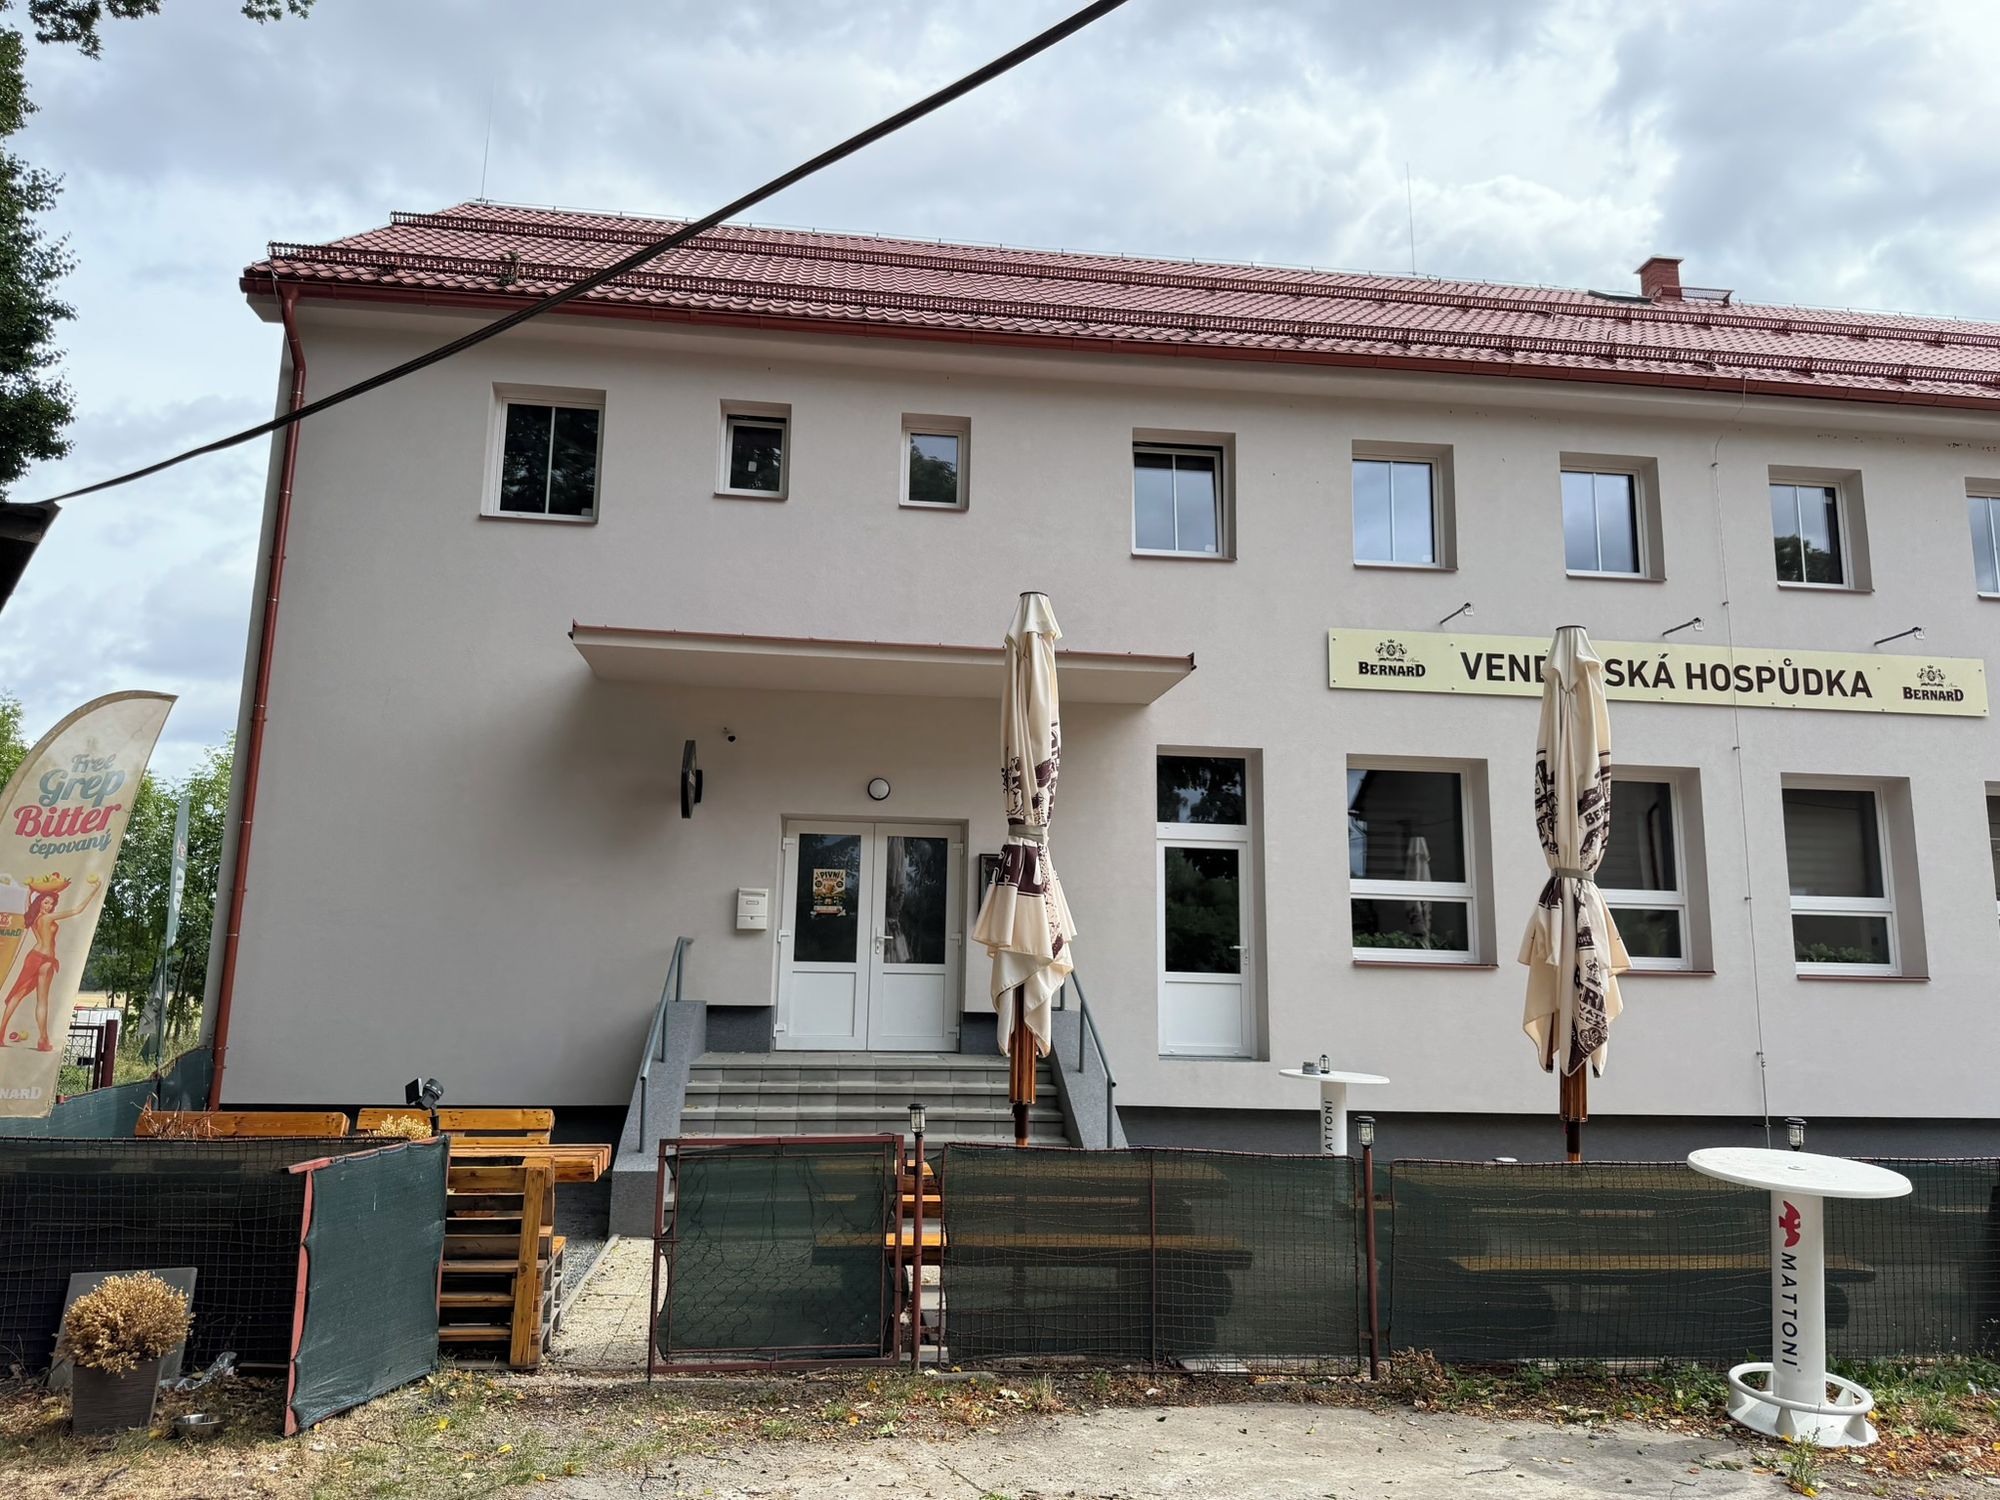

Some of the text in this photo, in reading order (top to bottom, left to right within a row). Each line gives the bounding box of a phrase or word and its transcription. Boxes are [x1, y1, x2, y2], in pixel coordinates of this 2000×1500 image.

[1358, 661, 1426, 678] BERNARD
[1460, 651, 1873, 698] VENSKÁ HOSPŮDKA
[1902, 686, 1964, 702] BERNARD
[39, 768, 126, 808] Grep
[14, 803, 122, 837] Bitter
[29, 828, 113, 860] čepovaný
[1324, 1100, 1333, 1154] ATTONI
[1781, 1251, 1798, 1366] MATTONI
